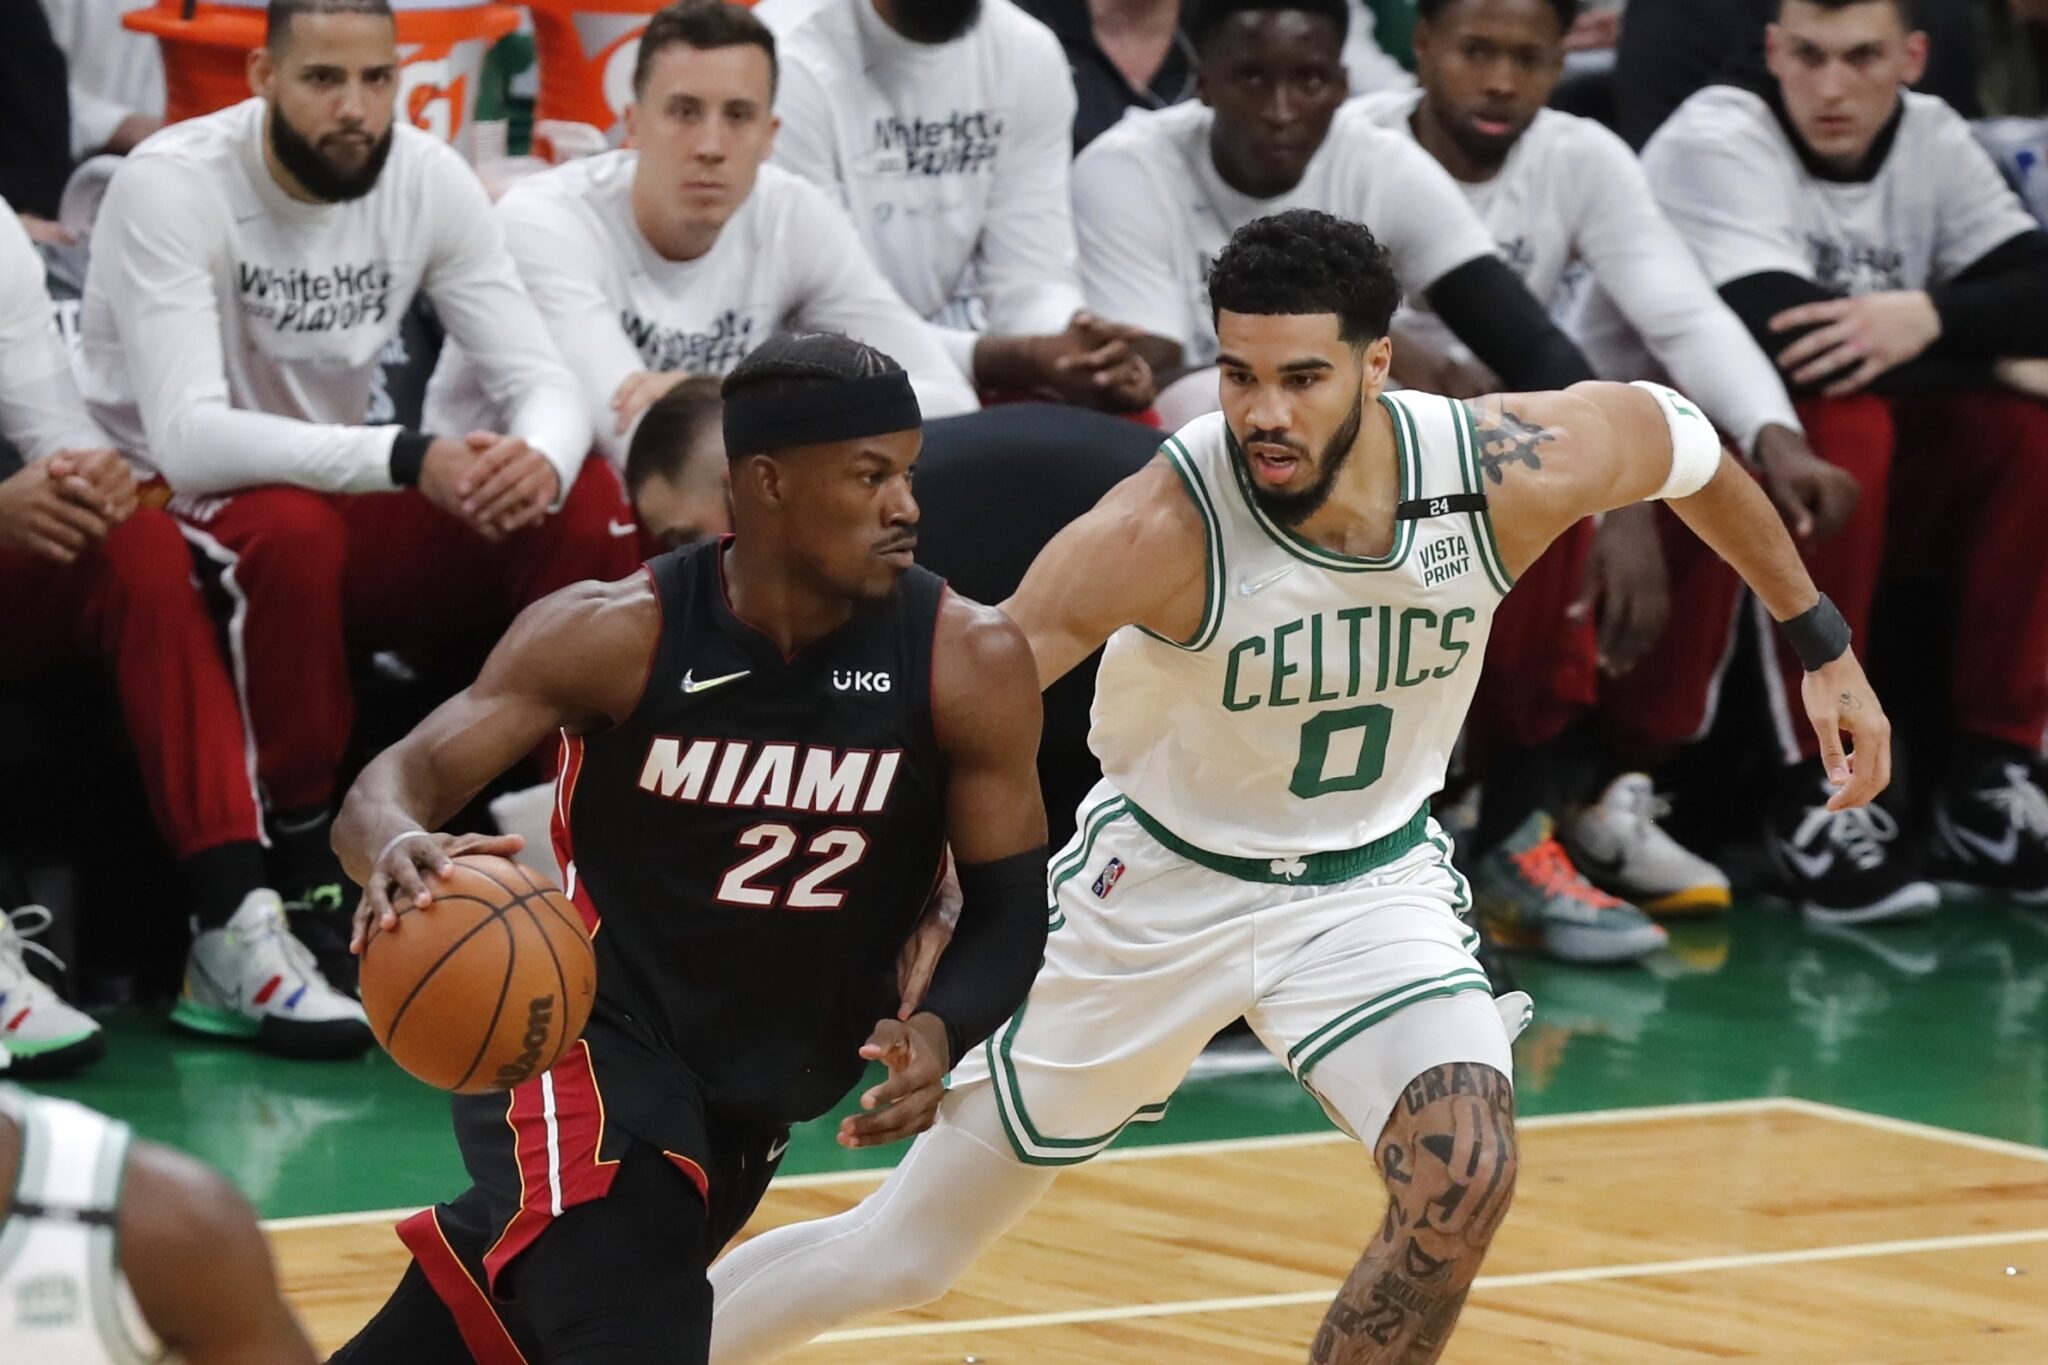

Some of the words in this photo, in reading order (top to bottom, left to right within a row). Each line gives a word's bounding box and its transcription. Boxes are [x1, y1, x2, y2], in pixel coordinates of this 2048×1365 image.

[1429, 497, 1450, 516] 24
[1419, 535, 1469, 570] VISTA
[1424, 557, 1470, 588] PRINT
[1222, 605, 1475, 712] CELTICS
[638, 735, 902, 815] MIAMI
[1288, 703, 1394, 800] 0
[714, 821, 869, 909] 22
